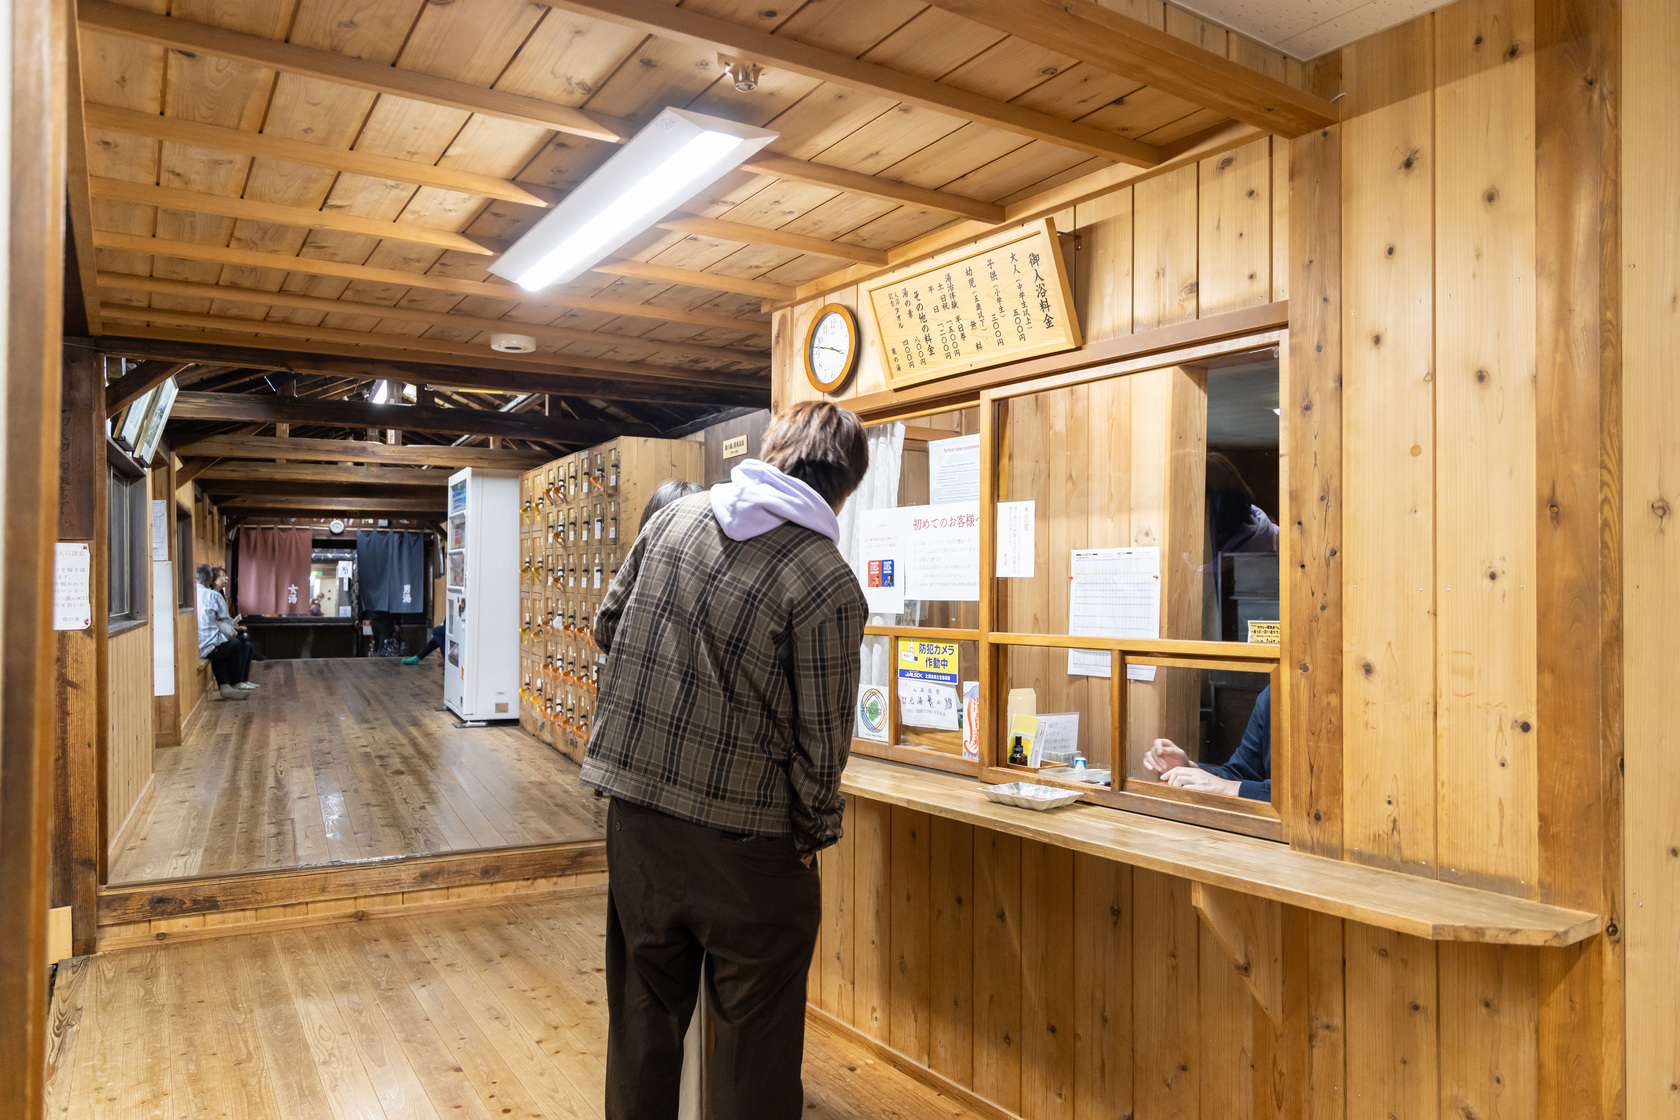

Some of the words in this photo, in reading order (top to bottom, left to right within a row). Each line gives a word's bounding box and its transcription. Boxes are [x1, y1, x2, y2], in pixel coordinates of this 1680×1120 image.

[1028, 252, 1054, 329] 御入浴料金
[913, 290, 935, 356] その他の料金
[288, 583, 299, 604] 女湯
[918, 642, 955, 656] 防犯カメラ
[925, 657, 949, 669] 作動中
